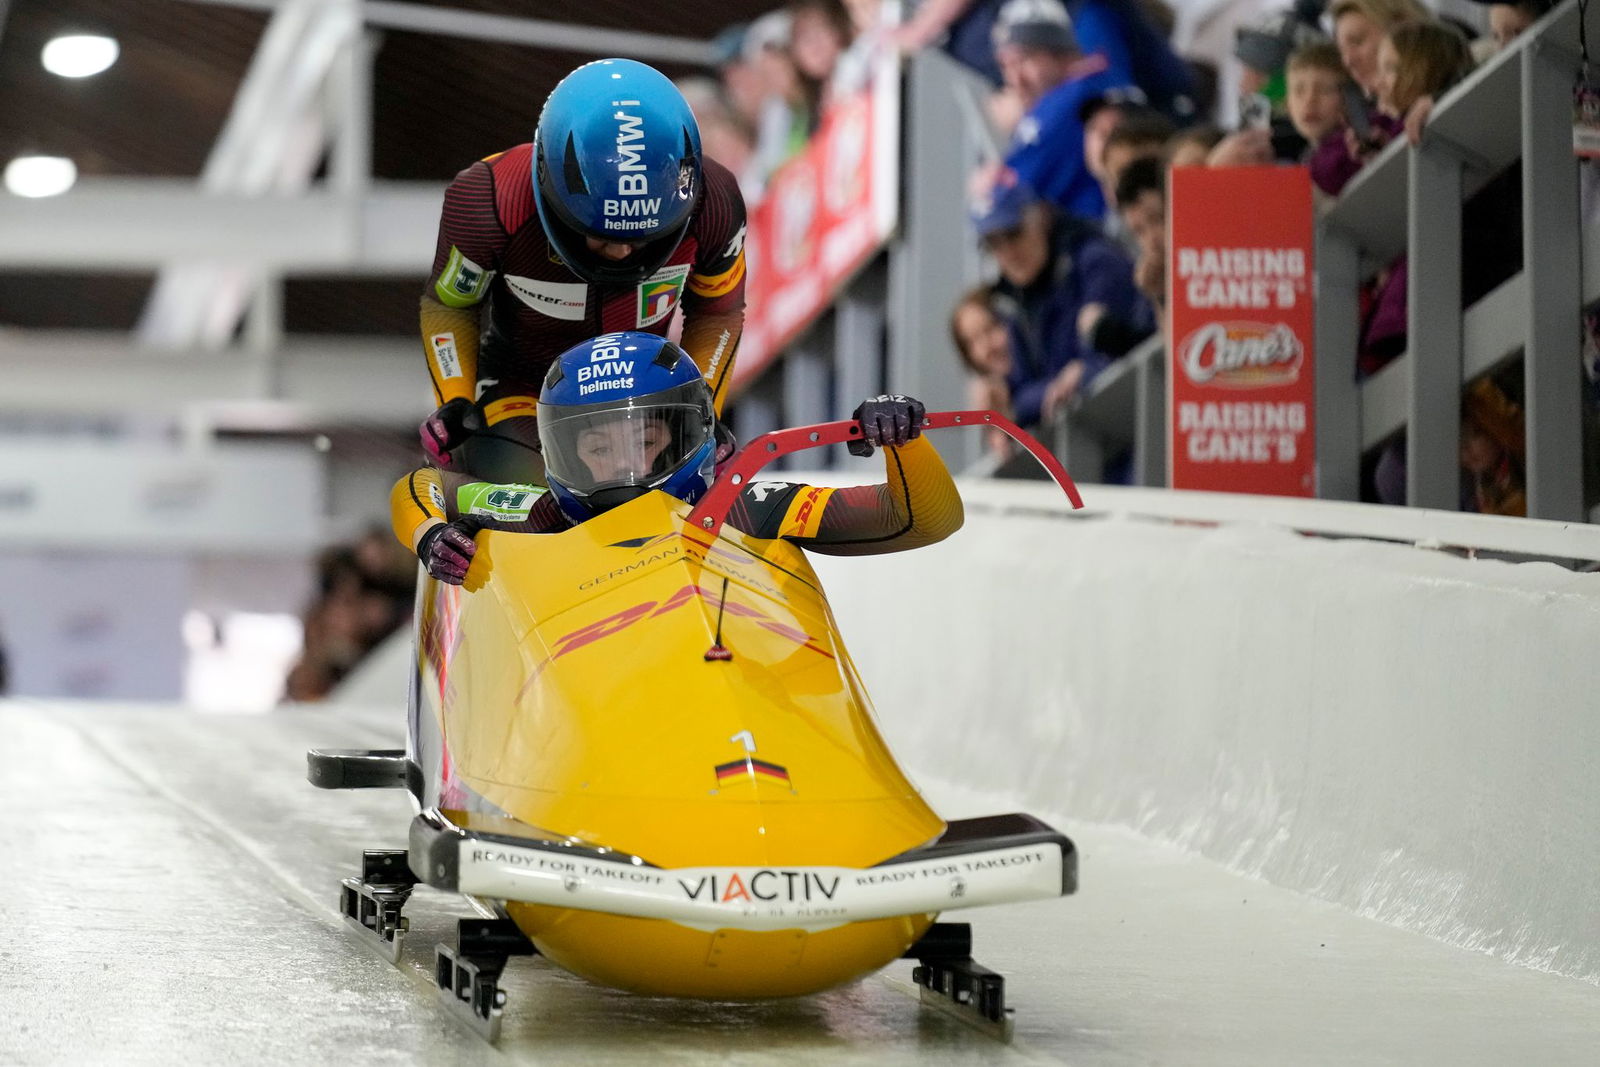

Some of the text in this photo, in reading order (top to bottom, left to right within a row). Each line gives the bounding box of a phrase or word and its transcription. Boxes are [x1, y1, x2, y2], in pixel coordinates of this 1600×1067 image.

[614, 107, 648, 196] BMW
[604, 198, 661, 216] BMW
[604, 218, 659, 231] helmets
[1178, 247, 1305, 278] RAISING
[1186, 278, 1297, 309] CANE'S
[578, 361, 635, 382] BMW
[580, 377, 634, 396] helmets
[1178, 402, 1306, 433] RAISING
[1187, 432, 1298, 463] CANE'S
[451, 531, 472, 548] SEIZ
[579, 546, 680, 592] GERMAN
[472, 849, 665, 886] READY FOR TAKEOFF
[856, 851, 1045, 887] READY FOR TAKEOFF
[677, 870, 841, 903] VIACTIV
